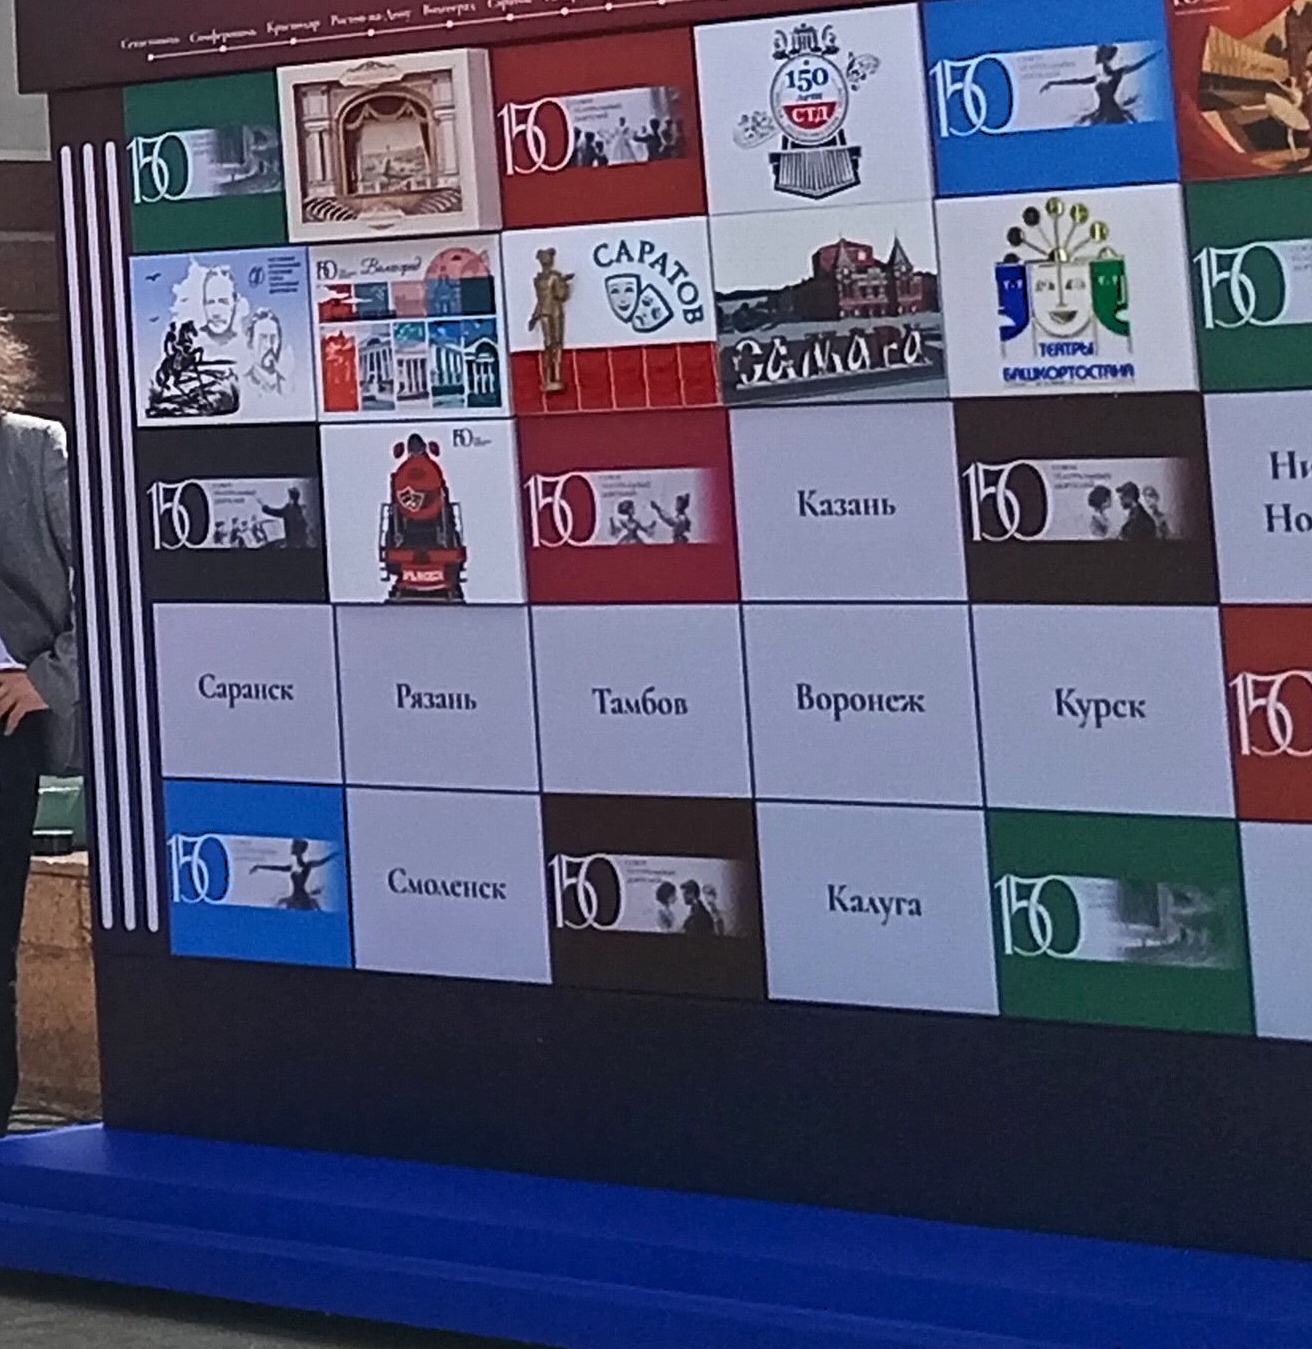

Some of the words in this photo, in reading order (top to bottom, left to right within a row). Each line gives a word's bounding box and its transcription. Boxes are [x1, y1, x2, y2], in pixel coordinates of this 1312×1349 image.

[785, 67, 829, 92] 150
[930, 54, 1019, 138] 150
[497, 97, 580, 176] 150
[792, 107, 827, 123] СТД
[126, 132, 193, 204] 150
[593, 239, 704, 324] САРАТОВ
[1193, 241, 1290, 329] 150
[1039, 342, 1094, 357] ТЕАТРЫ
[146, 478, 211, 550] 150
[522, 471, 598, 548] 150
[798, 490, 896, 518] Казань
[962, 460, 1054, 542] 150
[198, 673, 294, 708] Саранск
[396, 683, 477, 711] Рязань
[592, 686, 688, 716] Тамбов
[796, 683, 925, 727] Воронеж
[1055, 687, 1146, 729] Курск
[167, 833, 232, 905] 150
[388, 867, 507, 901] Смоленск
[548, 853, 627, 930] 150
[827, 884, 922, 926] Калуга
[994, 874, 1083, 959] 150
